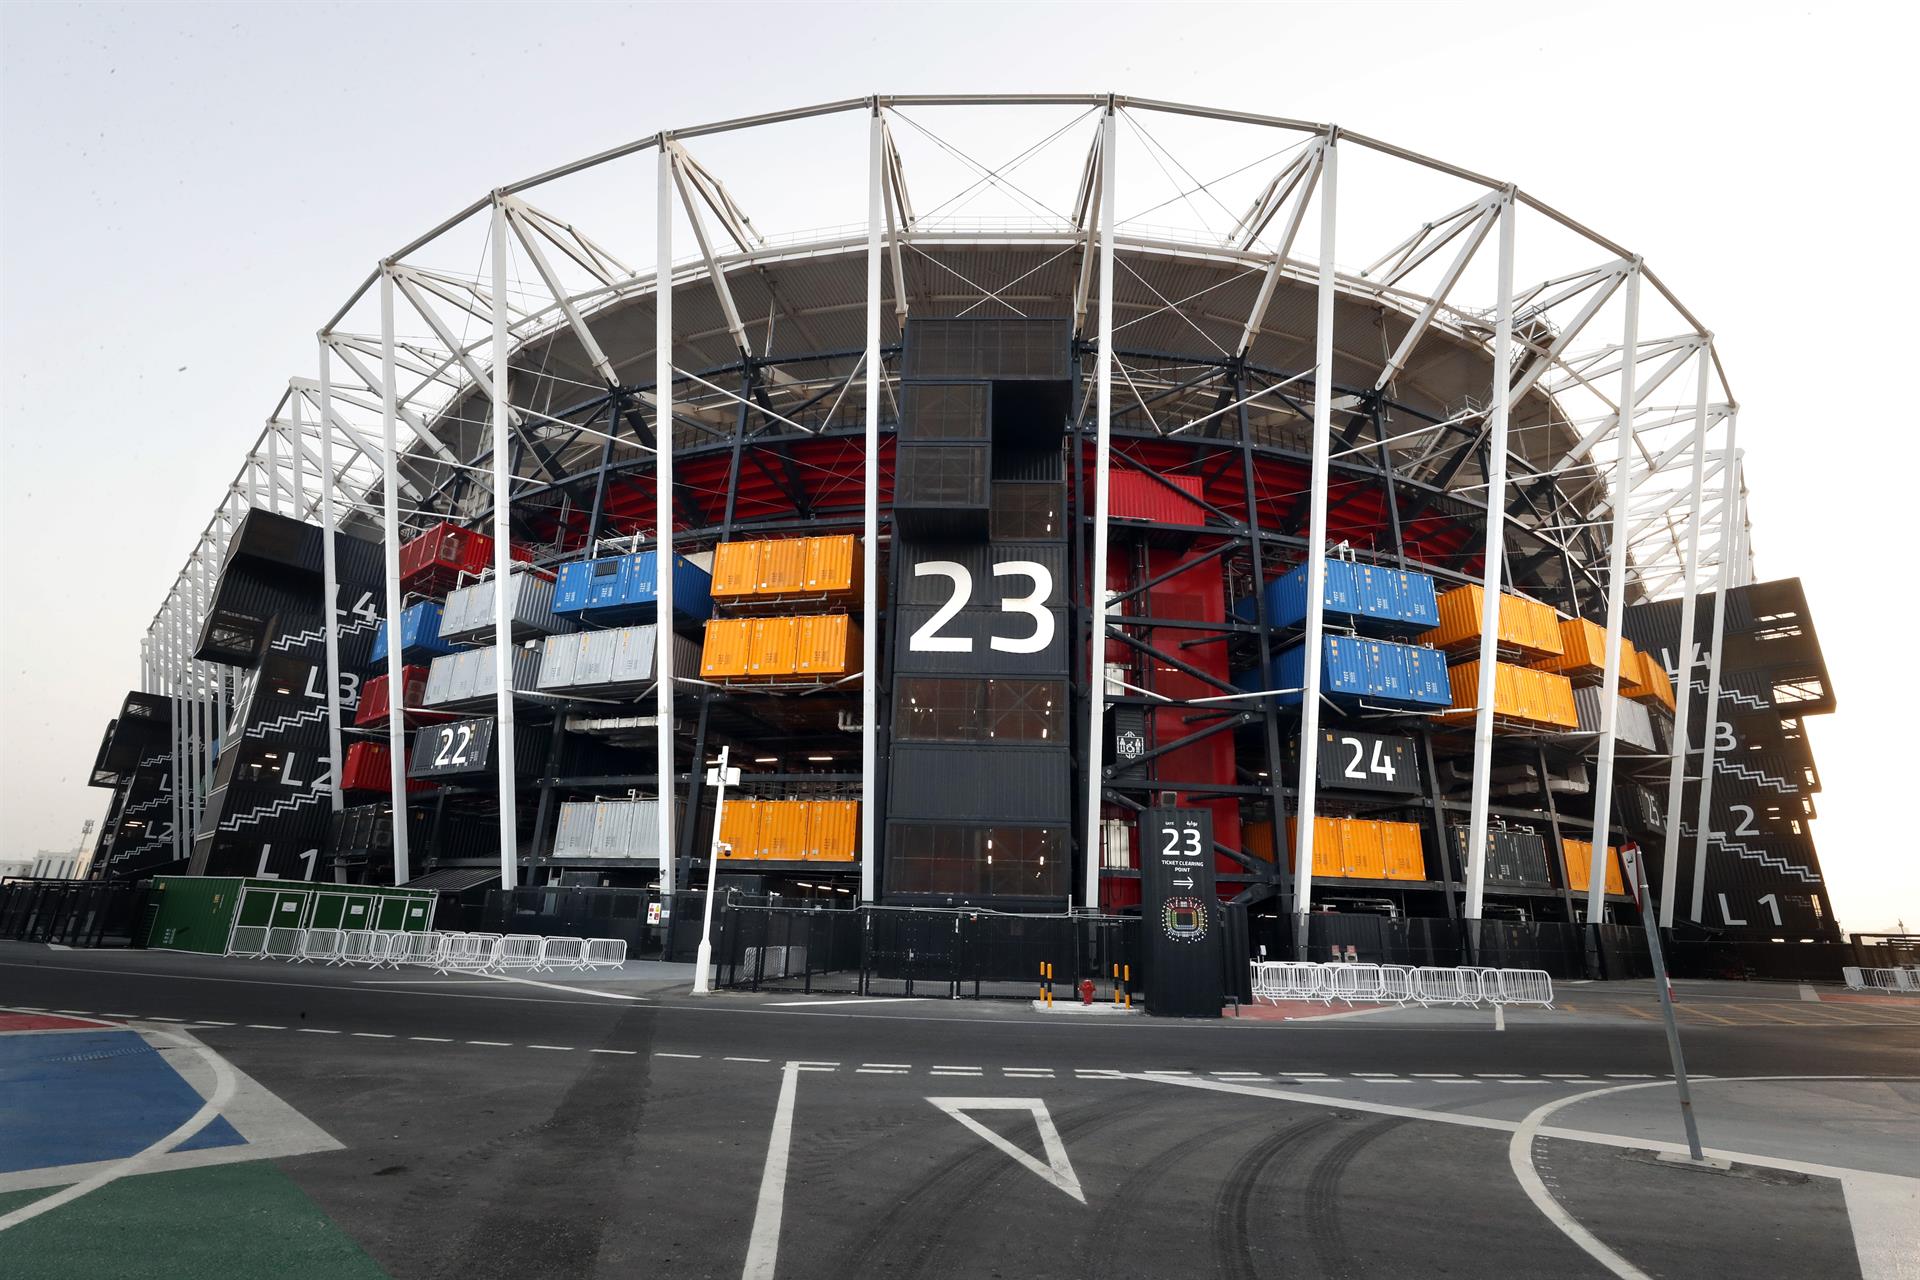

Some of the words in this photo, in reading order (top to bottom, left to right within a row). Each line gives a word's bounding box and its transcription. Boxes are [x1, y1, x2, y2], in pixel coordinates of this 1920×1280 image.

[910, 561, 1055, 653] 23
[304, 666, 360, 704] L3
[435, 726, 470, 766] 22
[1342, 738, 1396, 781] 24
[281, 752, 331, 788] L2
[1161, 828, 1202, 856] 23
